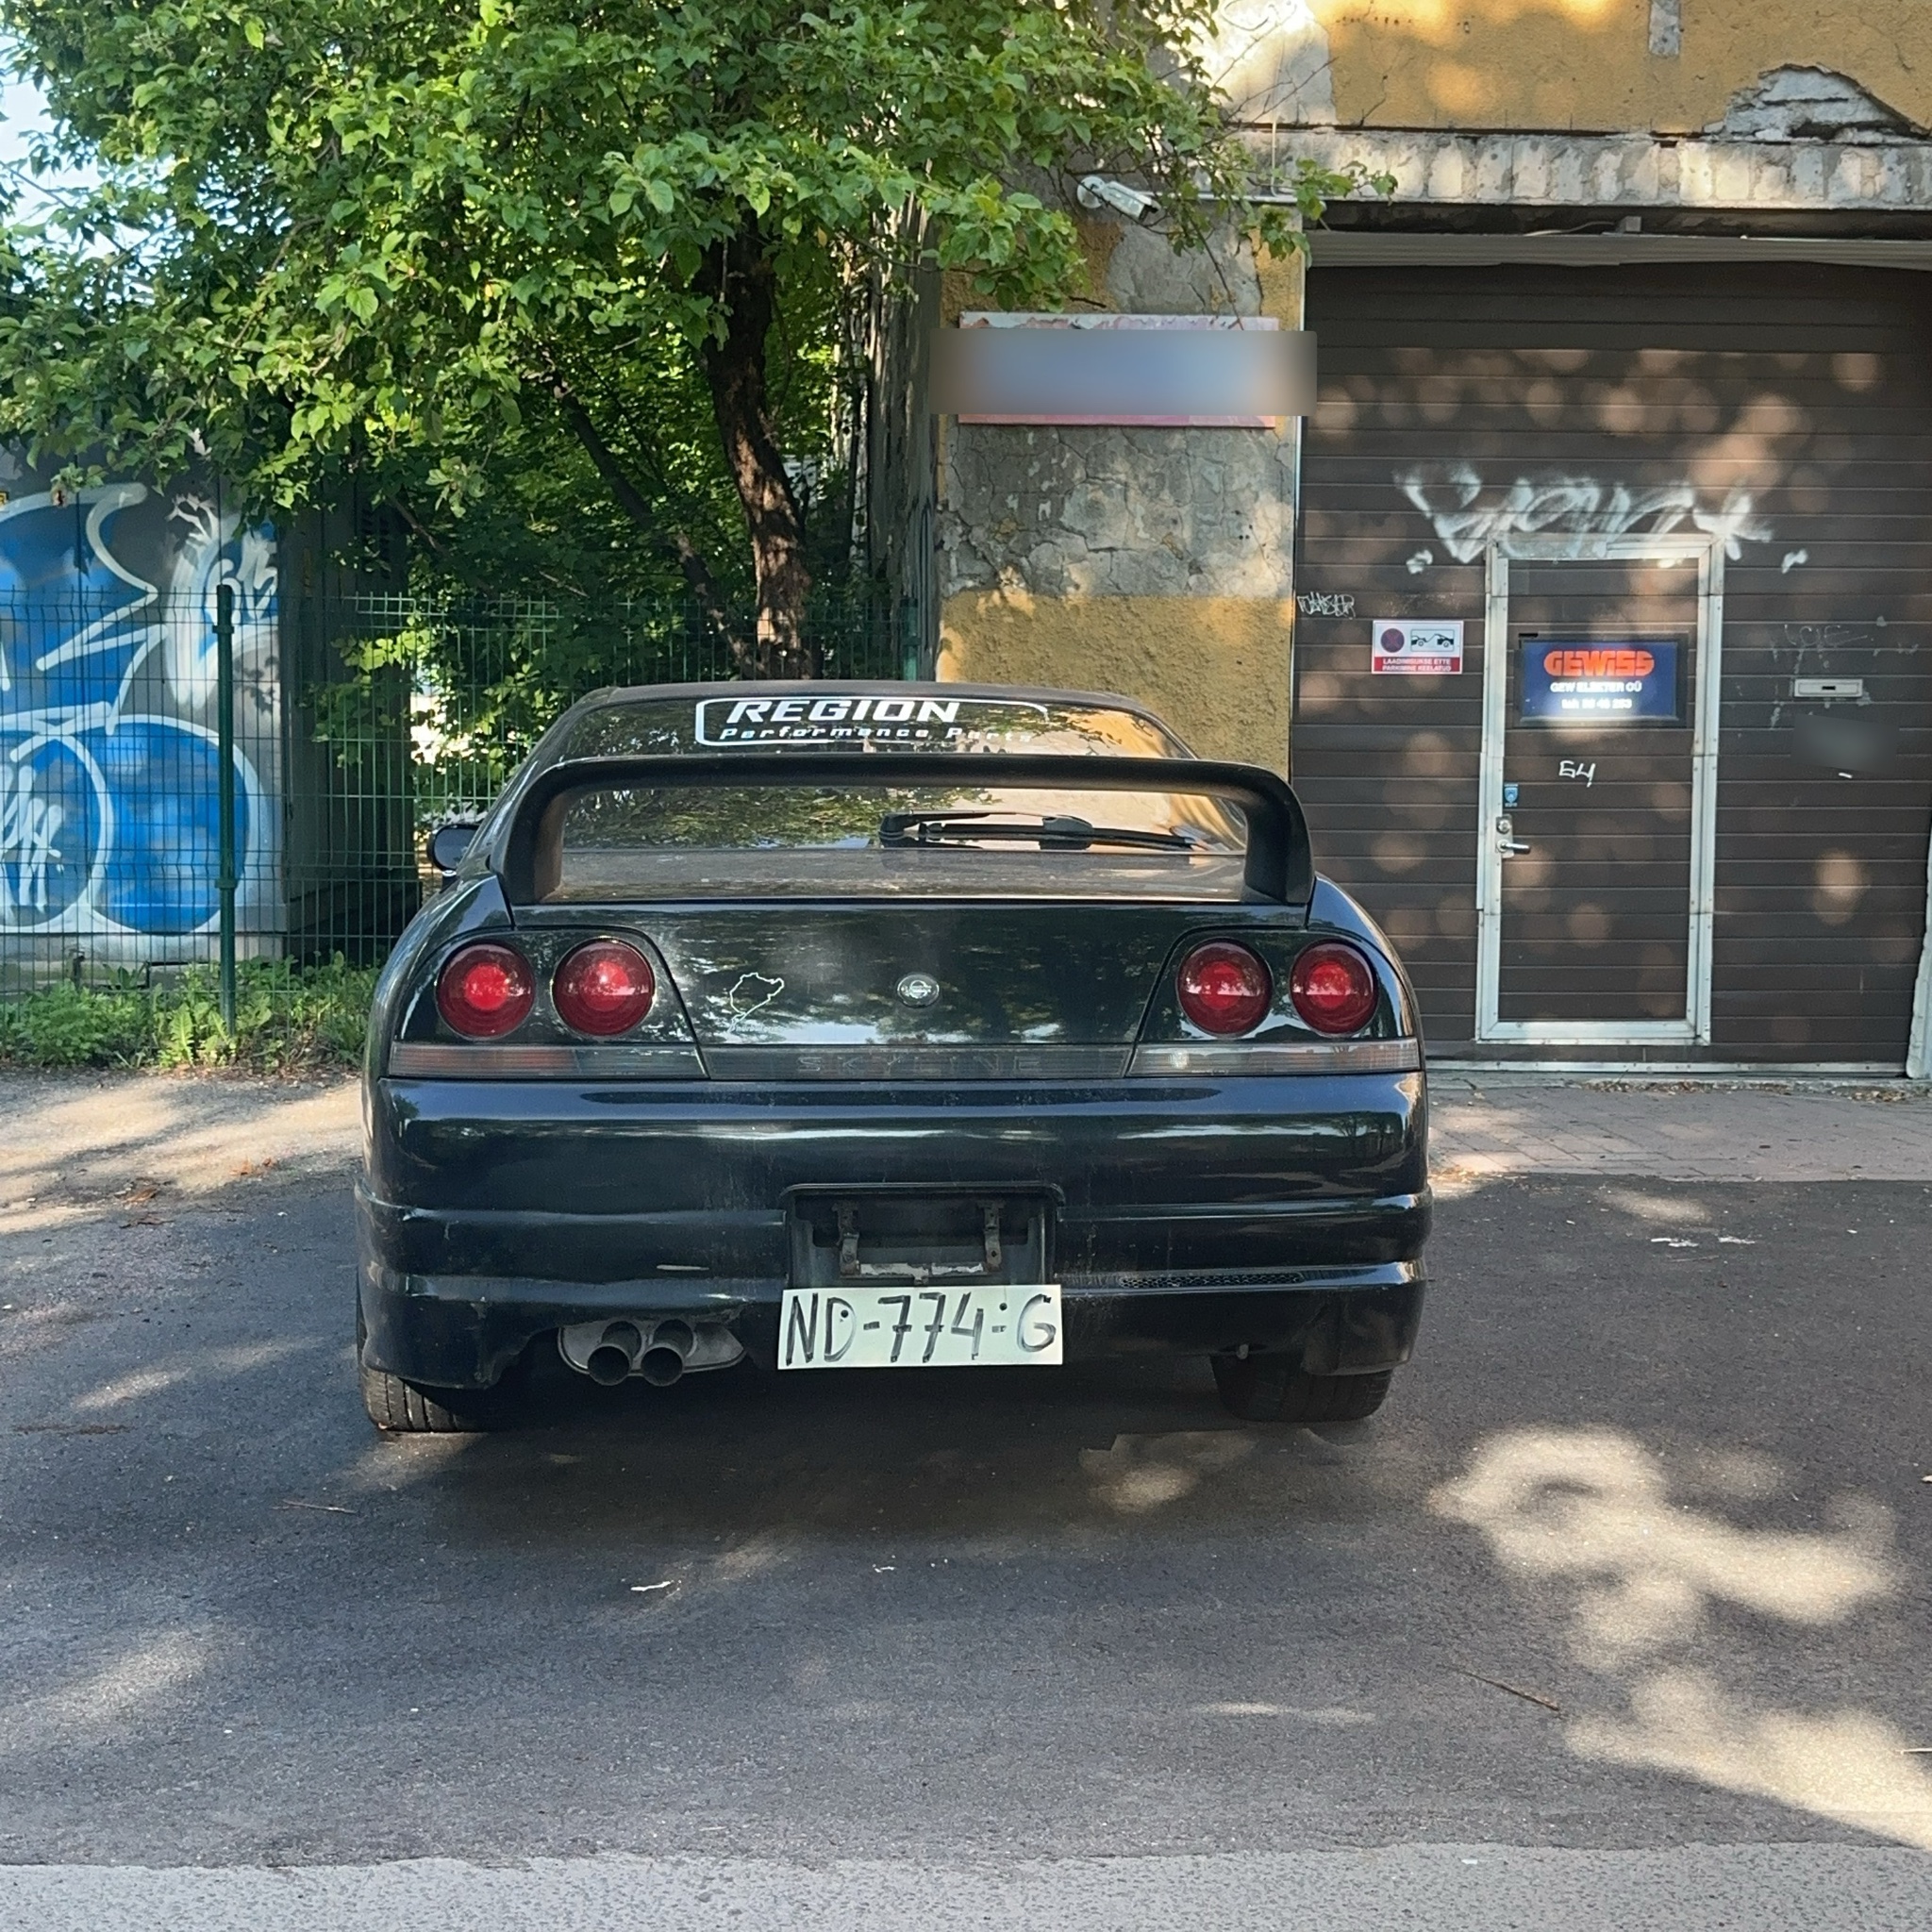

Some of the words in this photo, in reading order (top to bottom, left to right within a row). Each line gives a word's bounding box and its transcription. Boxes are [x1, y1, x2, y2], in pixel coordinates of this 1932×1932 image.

[1543, 650, 1655, 676] GEWISS
[726, 700, 960, 723] REGION
[720, 725, 929, 740] Performance
[798, 1056, 1042, 1077] SKYLINE
